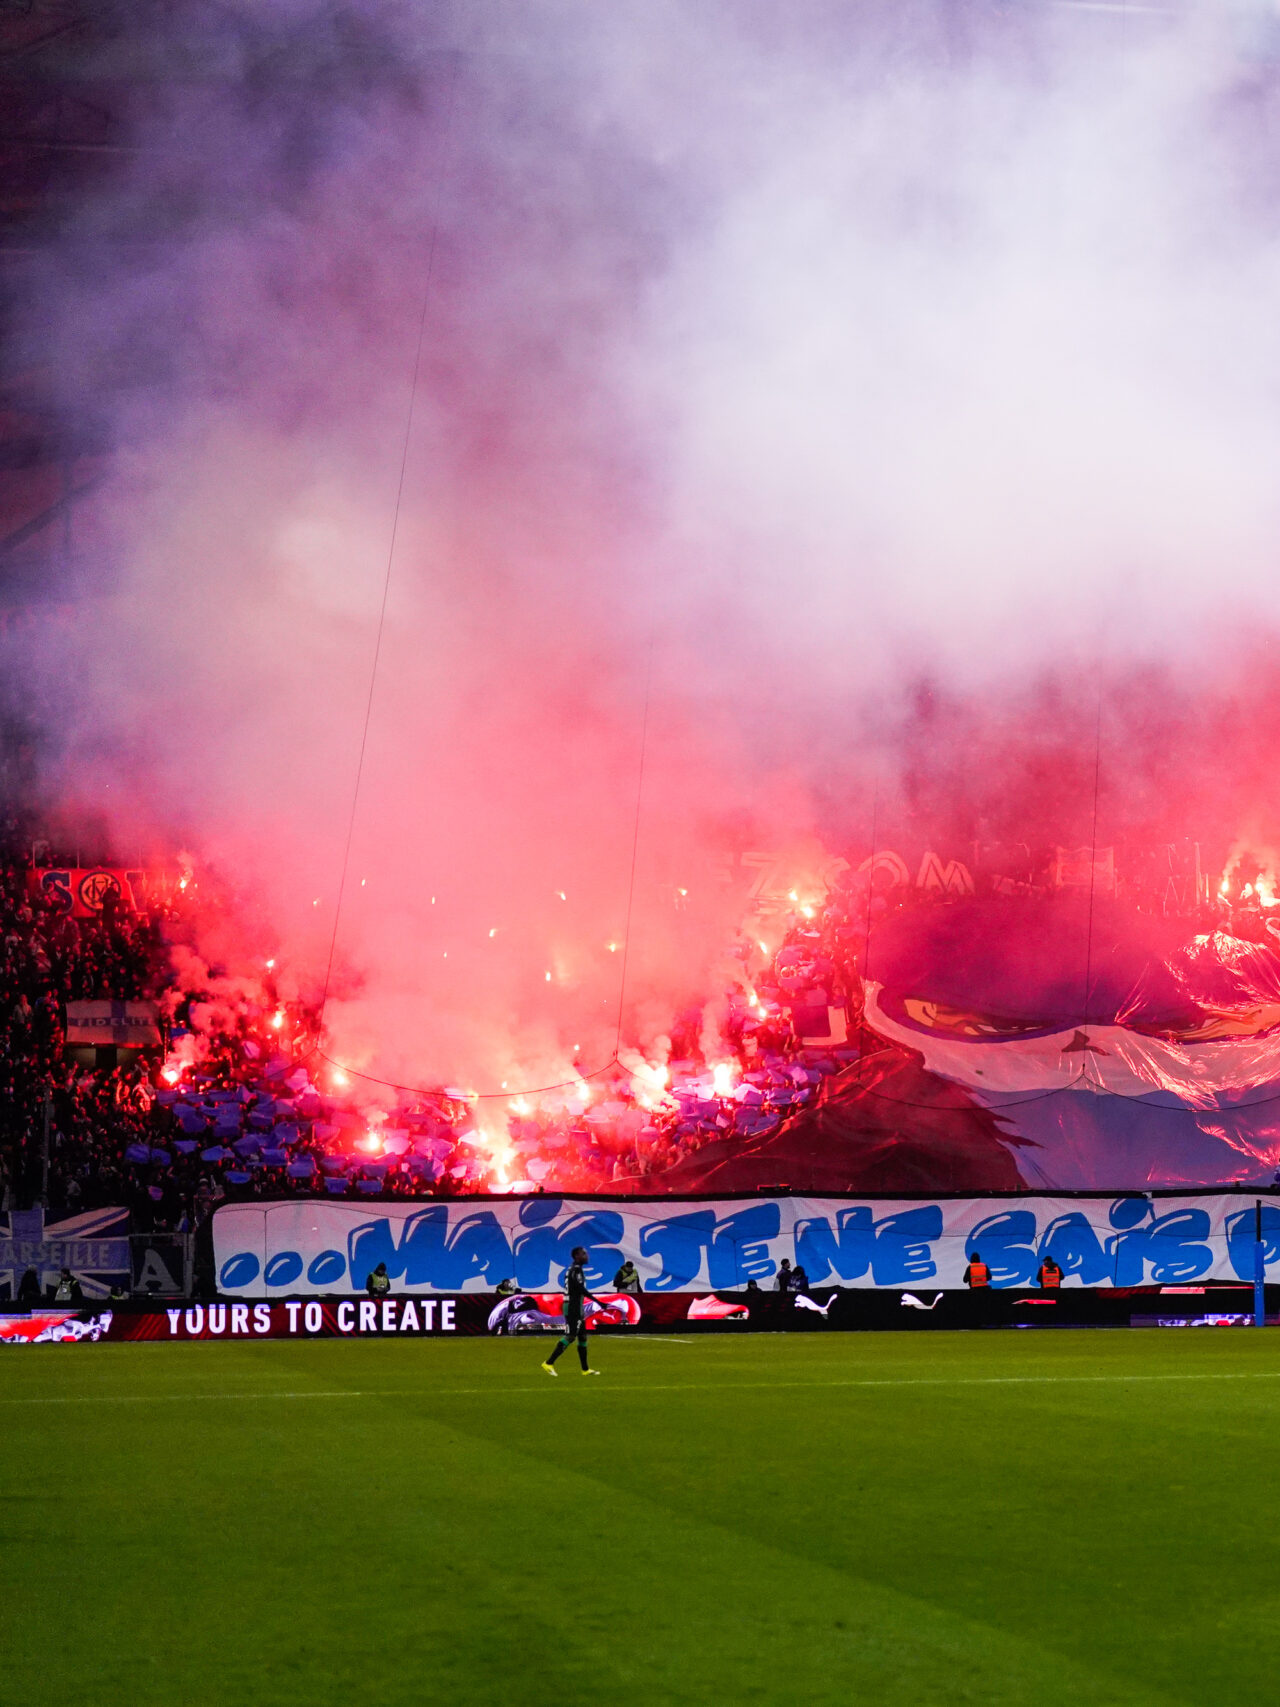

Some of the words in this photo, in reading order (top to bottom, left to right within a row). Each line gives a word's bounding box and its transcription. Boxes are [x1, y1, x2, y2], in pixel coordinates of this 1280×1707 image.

[0, 1240, 111, 1267] ARSEILLE
[166, 1303, 271, 1335] YOURS
[285, 1302, 323, 1332] TO
[337, 1300, 456, 1332] CREATE
